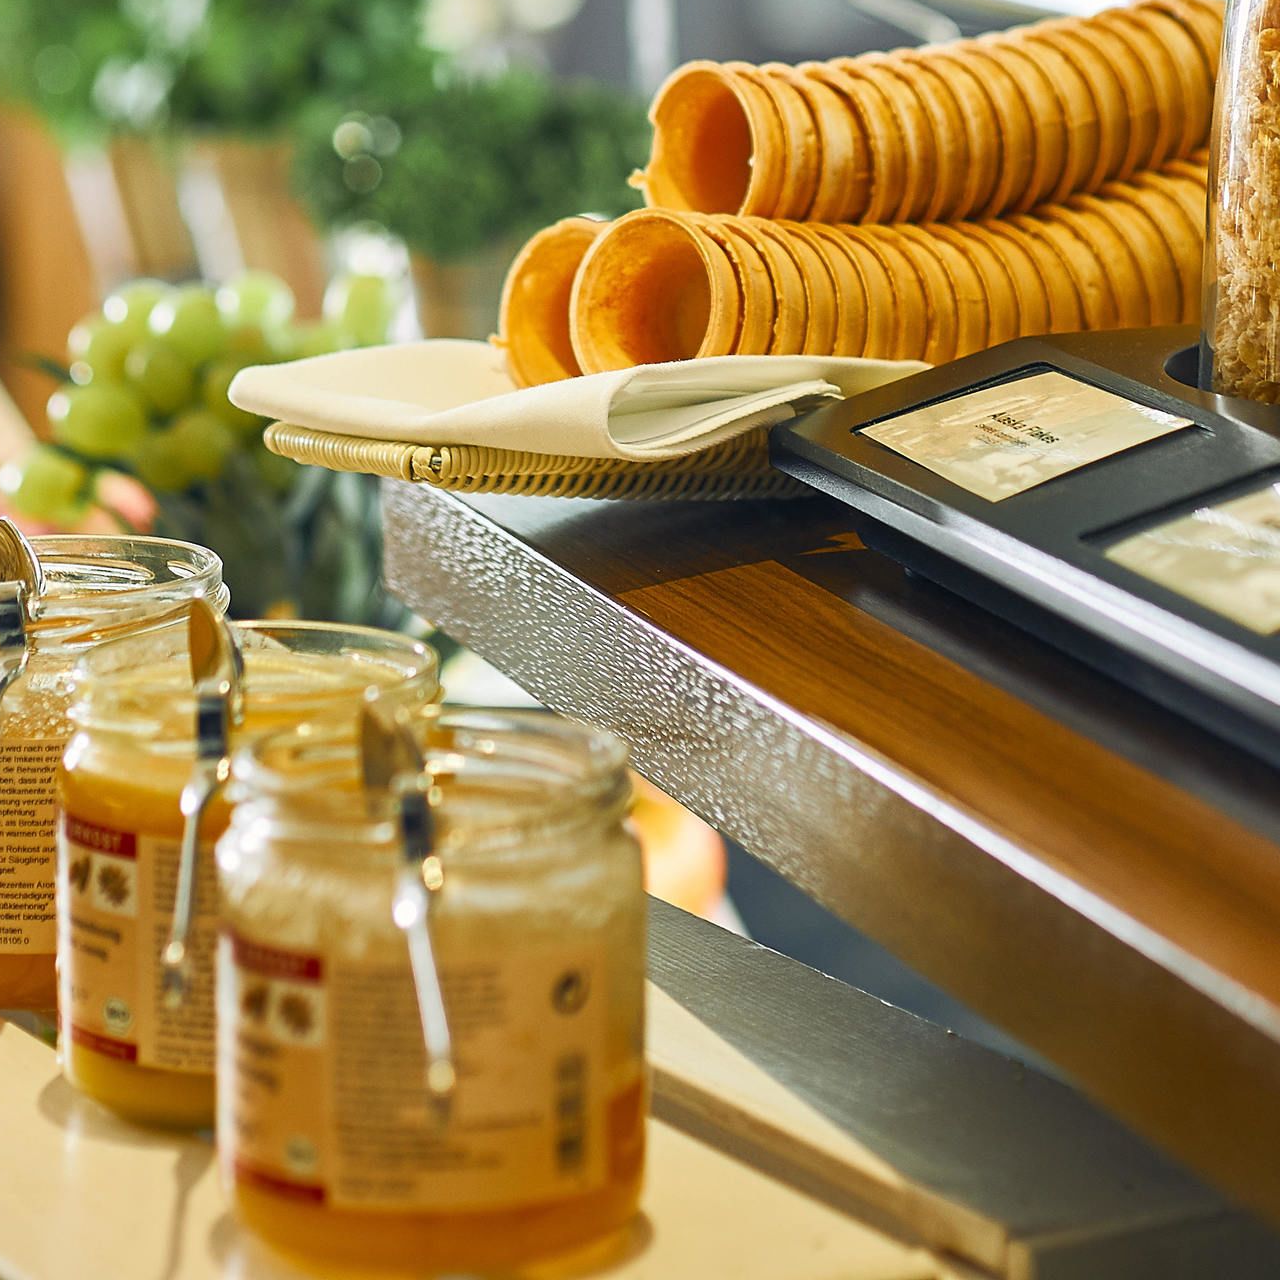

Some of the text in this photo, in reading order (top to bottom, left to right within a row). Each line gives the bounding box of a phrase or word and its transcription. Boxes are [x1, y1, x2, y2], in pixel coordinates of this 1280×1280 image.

[6, 744, 23, 752] wird
[24, 744, 42, 752] nach
[45, 744, 60, 752] den
[18, 776, 37, 784] dass
[6, 845, 40, 853] Rohkost
[0, 926, 23, 935] Italien
